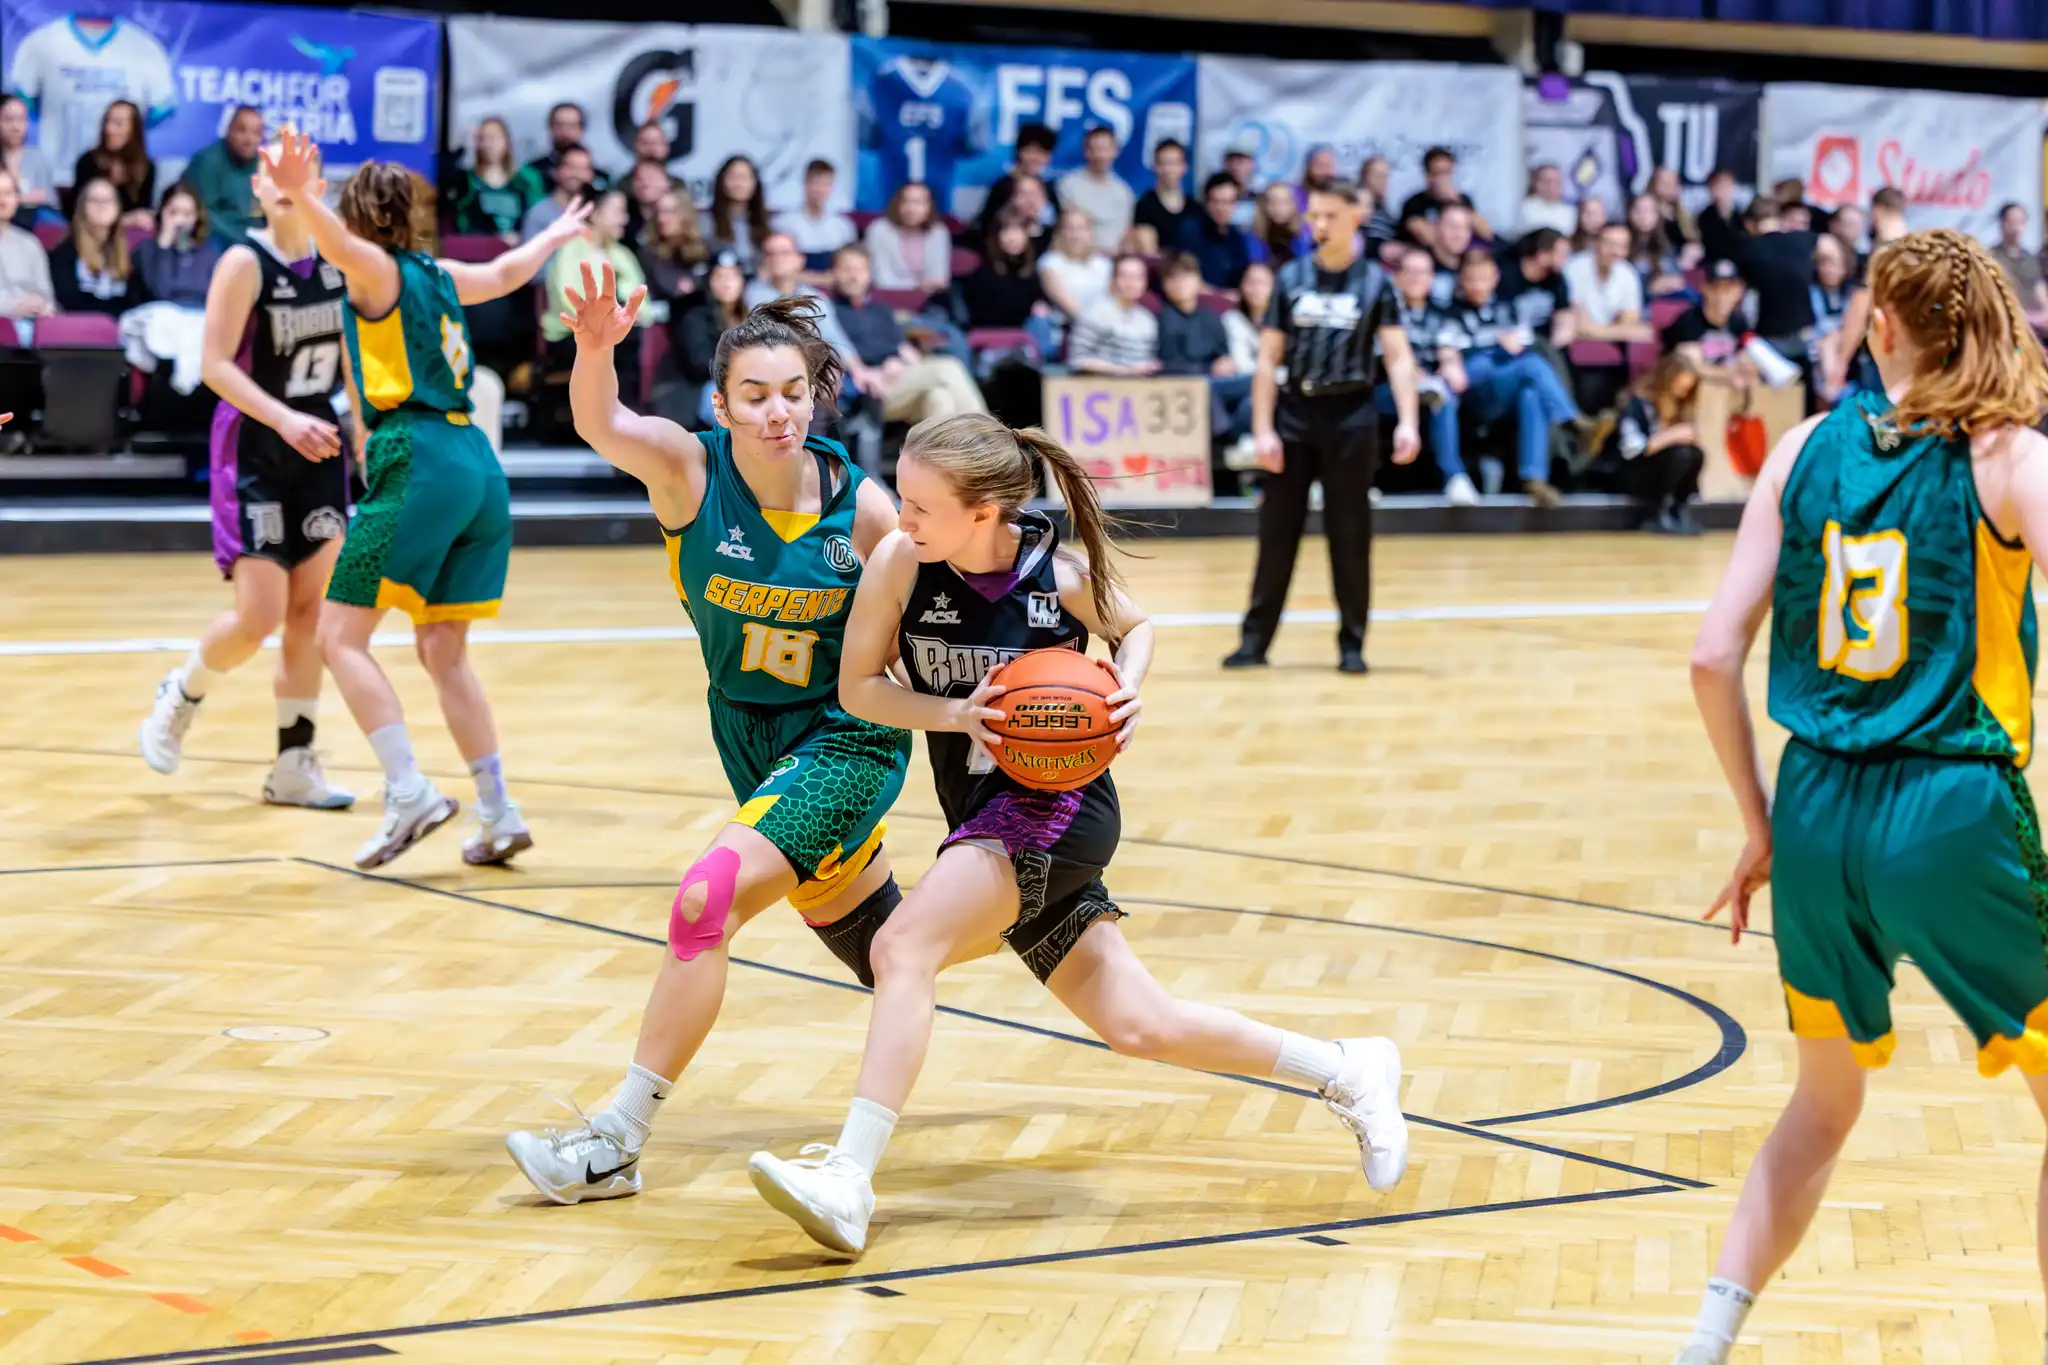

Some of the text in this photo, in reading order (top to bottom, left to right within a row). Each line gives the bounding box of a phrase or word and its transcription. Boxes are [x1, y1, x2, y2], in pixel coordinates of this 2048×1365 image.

[180, 66, 287, 106] TEACH
[1657, 102, 1718, 184] TU
[1876, 137, 1992, 209] Studo
[285, 341, 341, 399] 13
[1058, 388, 1197, 447] ISA 33
[715, 540, 755, 562] ACSL
[919, 610, 962, 624] ACSL
[1030, 593, 1060, 614] TU
[1817, 519, 1909, 682] 13
[1030, 618, 1060, 628] WIEN
[740, 621, 820, 688] 18
[1008, 714, 1092, 730] LEGACY
[1004, 745, 1097, 770] SPALDING
